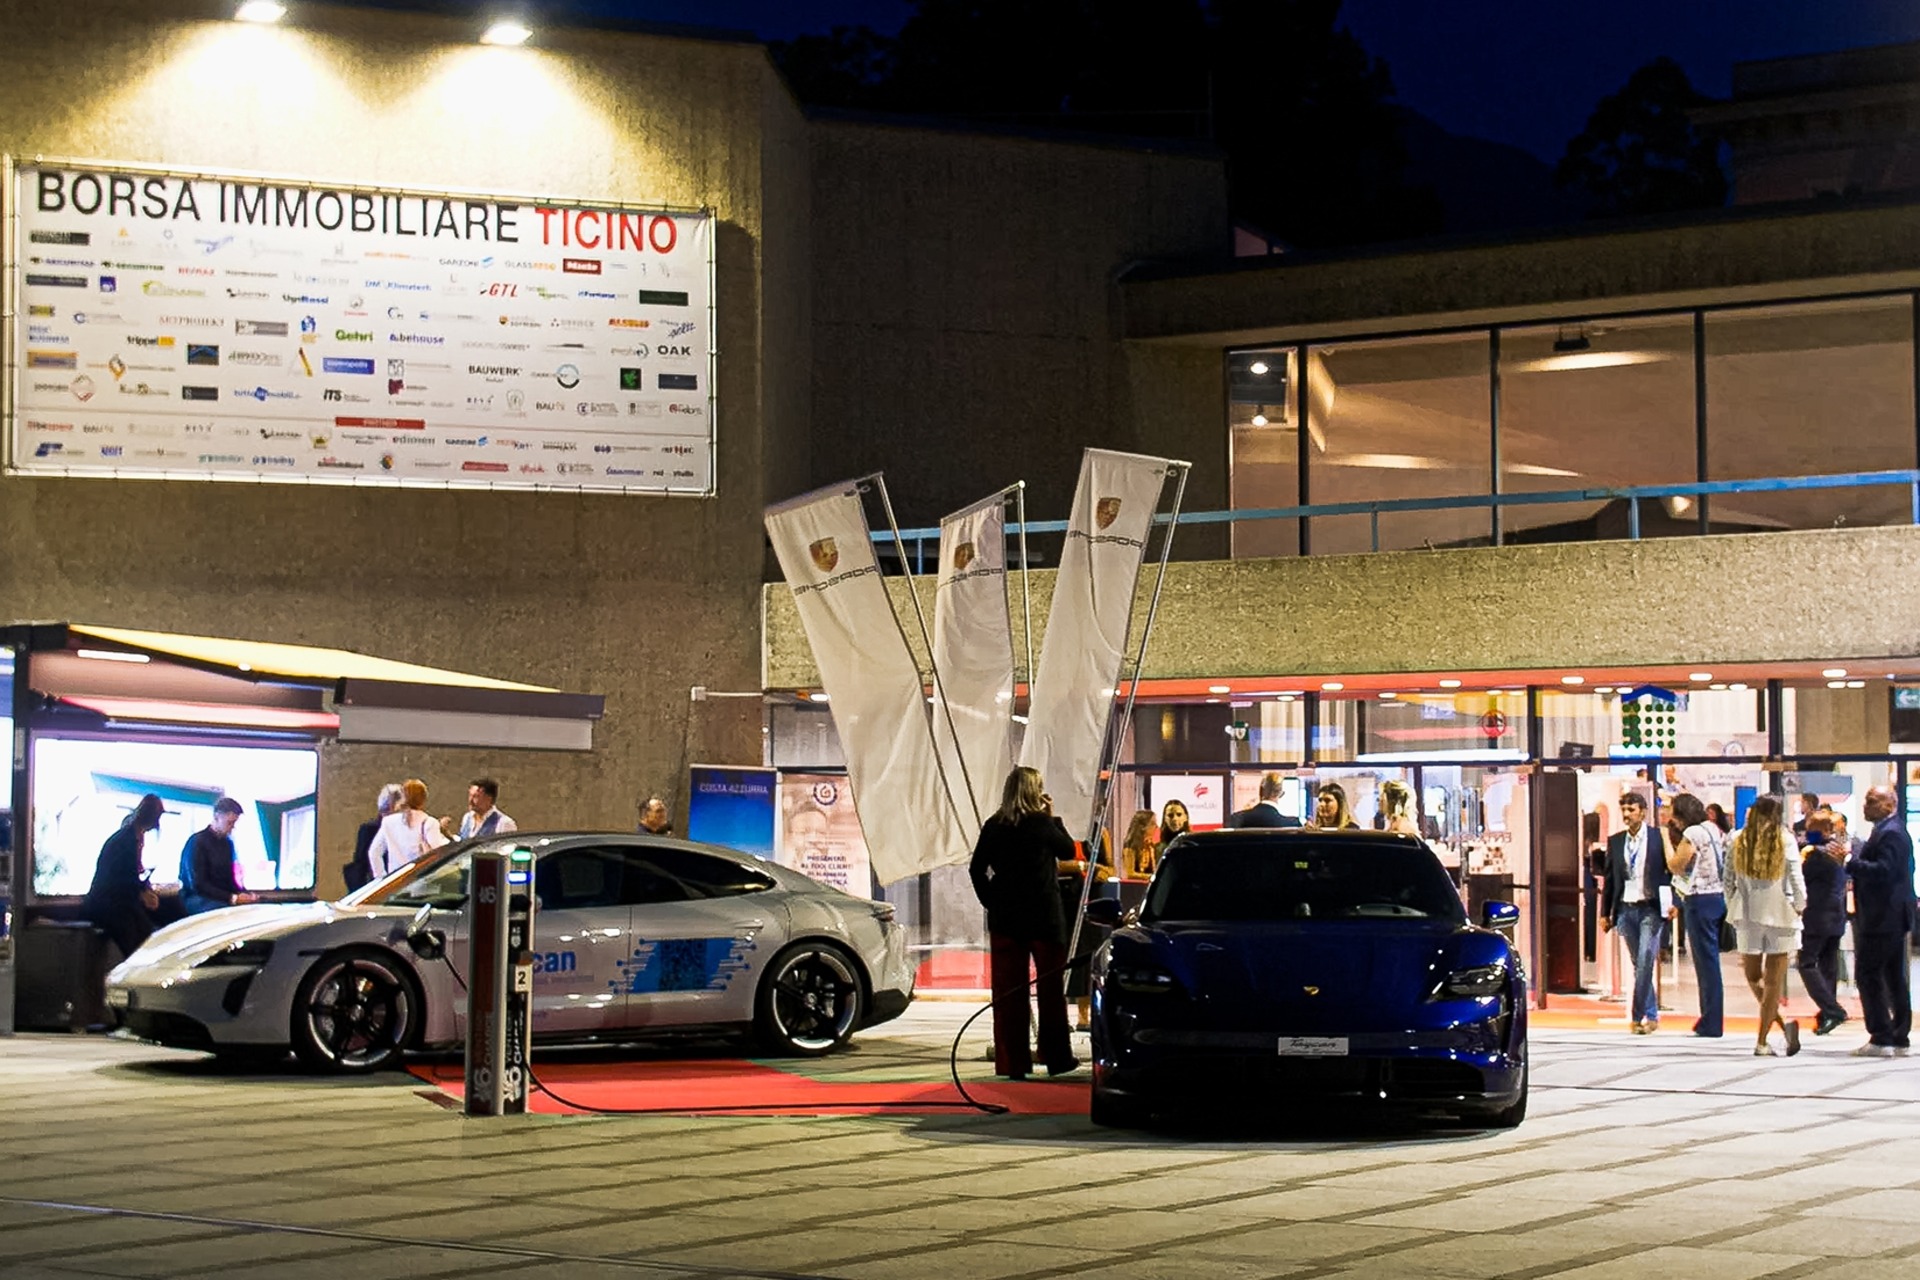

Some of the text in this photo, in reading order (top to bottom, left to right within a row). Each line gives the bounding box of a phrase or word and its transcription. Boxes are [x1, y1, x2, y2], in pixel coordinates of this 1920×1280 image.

[38, 171, 677, 253] BORSA IMMOBILIARE TICINO
[488, 282, 518, 298] GTL
[335, 329, 373, 342] Gehri
[657, 345, 691, 356] OAK
[469, 365, 520, 376] BAUWERK
[518, 971, 526, 984] 2
